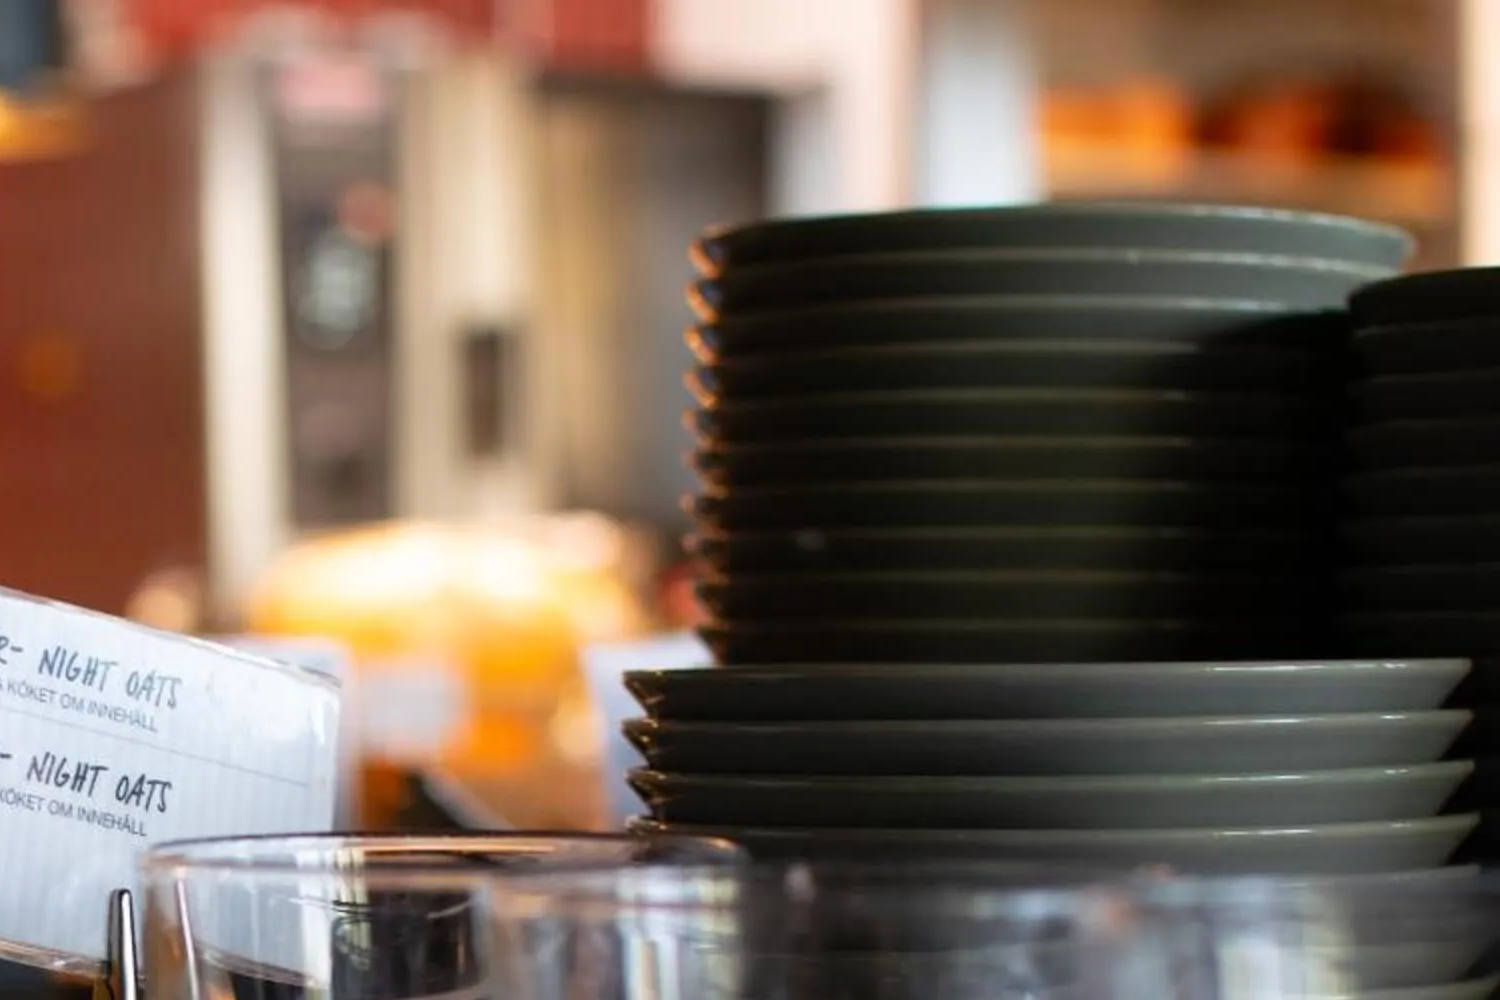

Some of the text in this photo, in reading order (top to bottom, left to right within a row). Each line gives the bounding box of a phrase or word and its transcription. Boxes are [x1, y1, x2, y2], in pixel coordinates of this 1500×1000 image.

[37, 645, 119, 693] NIGHT
[125, 669, 183, 710] OATS
[60, 692, 86, 713] OM
[26, 751, 110, 798] NIGHT
[115, 773, 173, 813] OATS
[47, 799, 74, 818] OM
